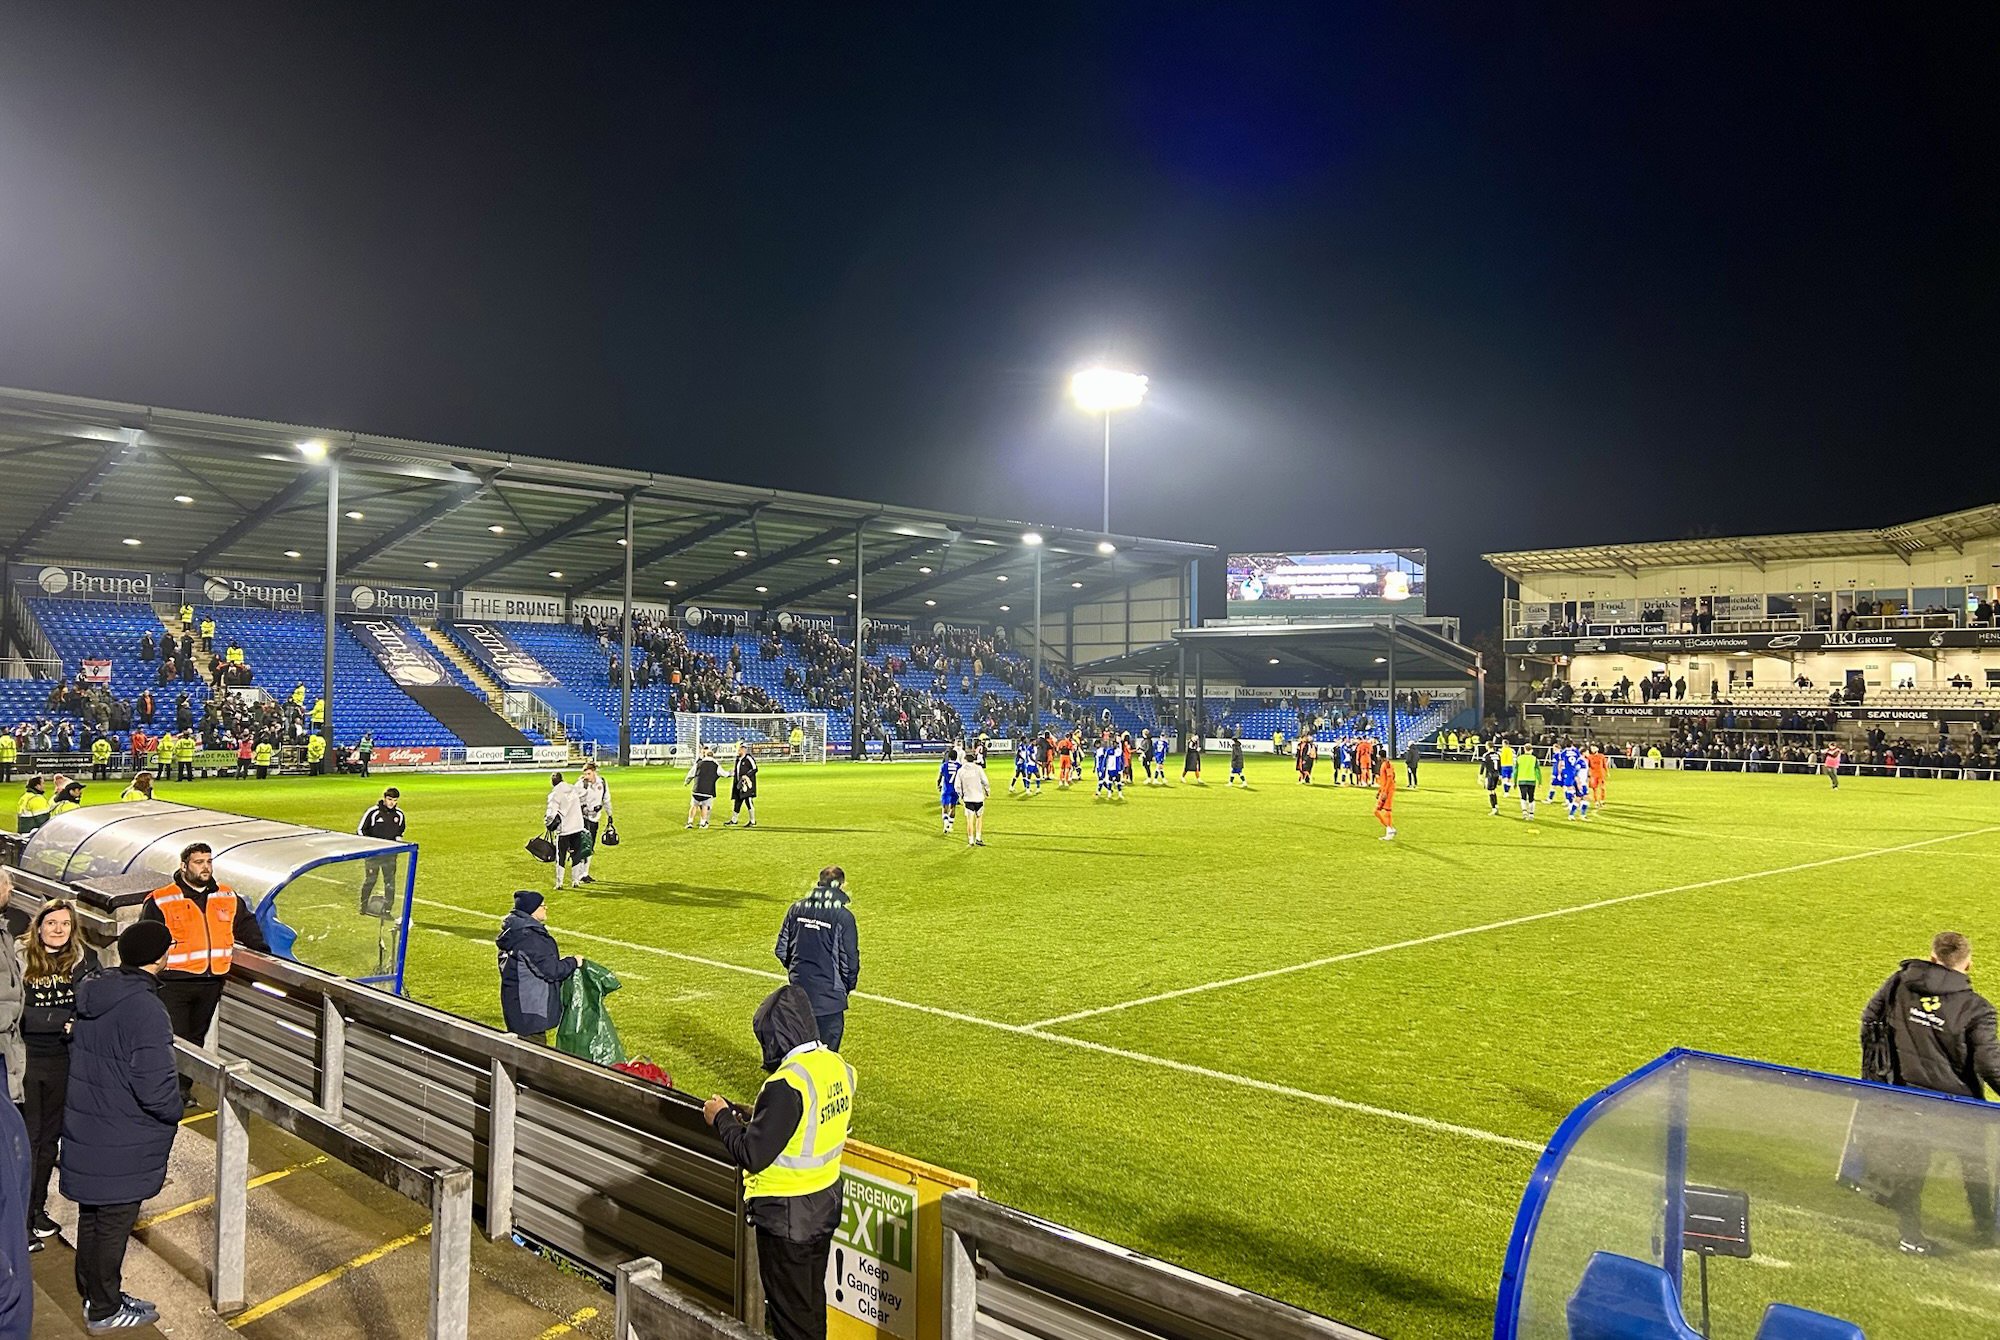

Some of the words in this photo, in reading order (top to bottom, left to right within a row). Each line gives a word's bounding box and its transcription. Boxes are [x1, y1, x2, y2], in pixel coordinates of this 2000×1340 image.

[71, 570, 151, 595] Brunel
[231, 580, 302, 603] Brunel
[376, 589, 439, 611] Brunel
[471, 598, 500, 614] THE
[506, 600, 563, 618] BRUNEL
[572, 604, 618, 620] GROUP
[1614, 626, 1626, 635] Up
[1627, 625, 1640, 633] the
[1645, 625, 1664, 633] Gas!
[1824, 633, 1857, 645] MKJ
[1858, 636, 1892, 644] GROUP
[1694, 638, 1748, 647] CaddyWindows
[1605, 707, 1625, 715] SEAT
[1625, 708, 1653, 716] UNIQUE
[1685, 709, 1715, 717] UNIQUE
[1867, 711, 1892, 719] SEAT
[388, 749, 428, 762] Kellogg's
[948, 770, 956, 784] 7
[820, 1095, 849, 1125] STEWARD
[843, 1178, 907, 1216] MERGENCY
[834, 1197, 907, 1263] EXIT
[859, 1256, 889, 1283] Keep
[847, 1273, 902, 1311] Gangway
[858, 1298, 890, 1324] Clear
